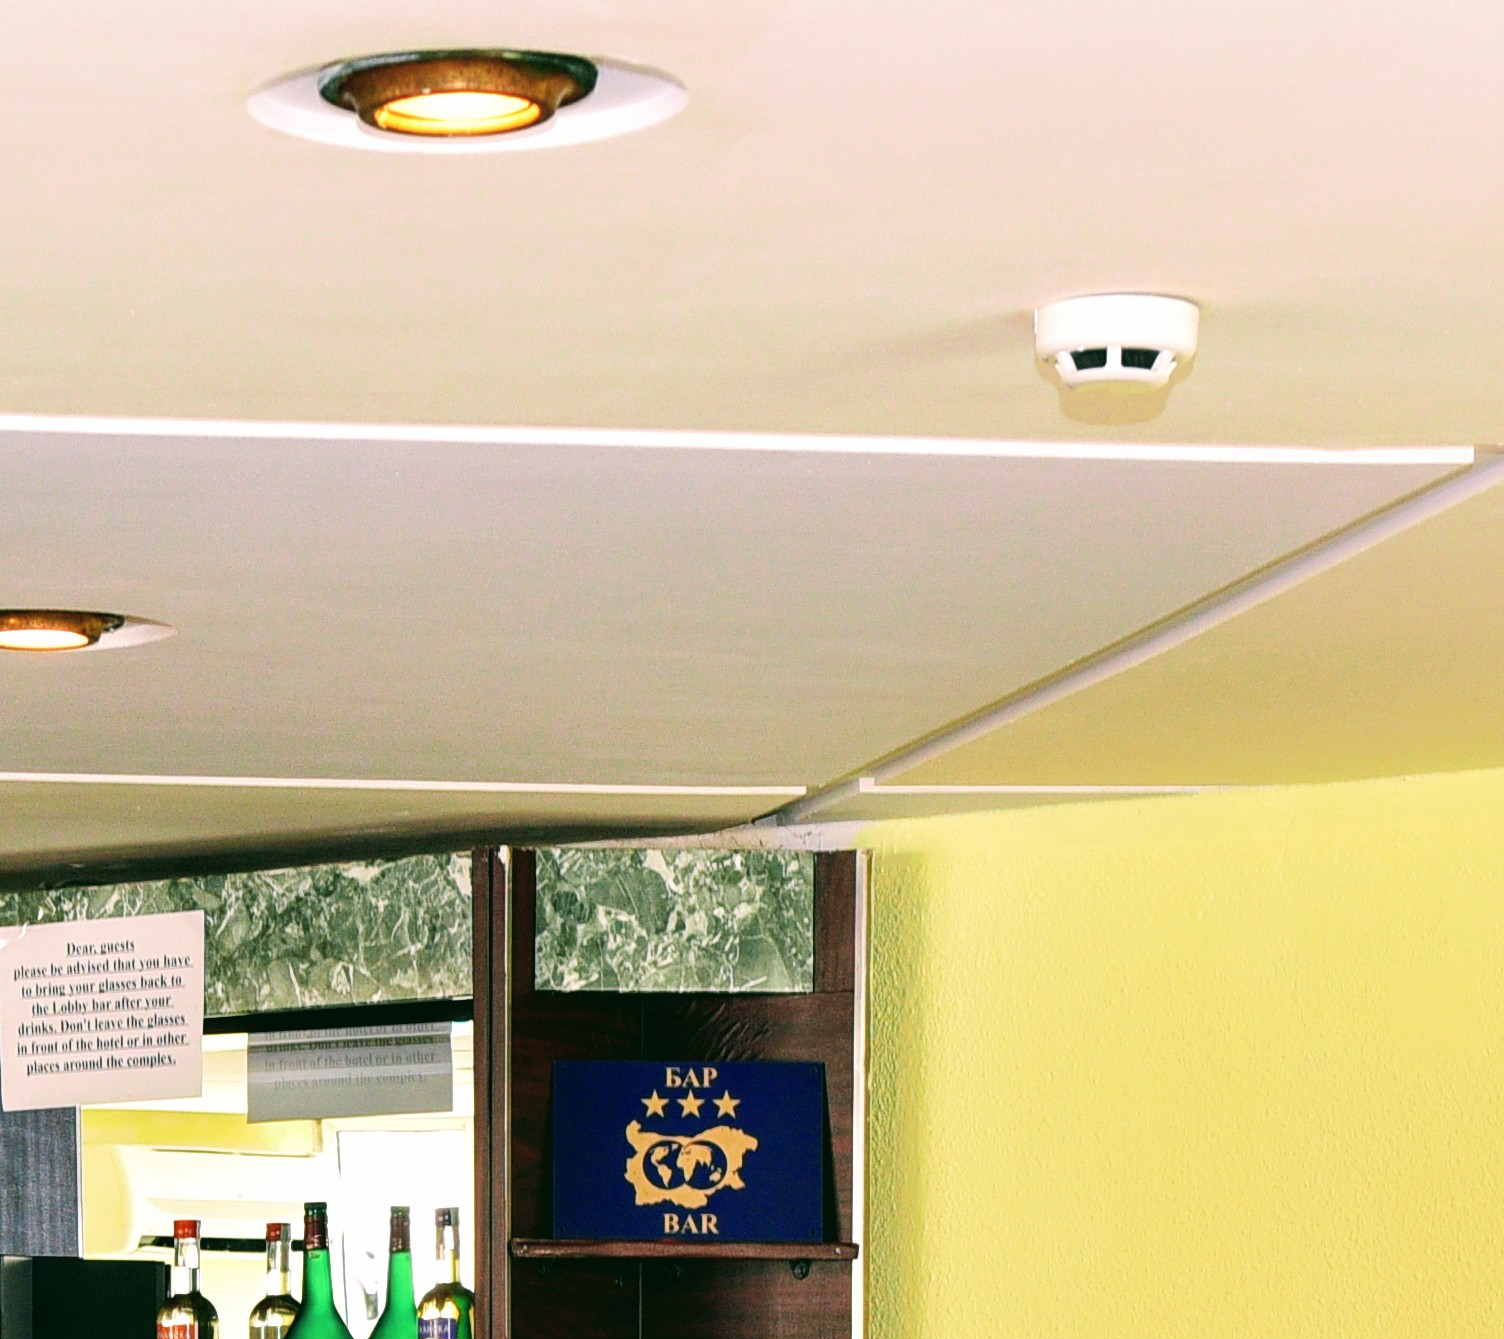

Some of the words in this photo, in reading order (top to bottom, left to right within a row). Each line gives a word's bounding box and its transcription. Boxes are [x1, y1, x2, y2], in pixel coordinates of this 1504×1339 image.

[66, 942, 97, 957] Dear,
[100, 940, 135, 955] guests
[13, 966, 47, 981] please
[50, 965, 63, 976] be
[67, 961, 109, 974] advised
[113, 959, 135, 972] that
[140, 959, 159, 971] you
[164, 954, 191, 968] have
[22, 986, 32, 998] to
[36, 985, 65, 997] bring
[69, 982, 95, 996] your
[99, 977, 136, 992] glasses
[141, 975, 166, 987] back
[171, 975, 182, 986] to
[32, 1005, 48, 1016] the
[53, 1002, 87, 1015] Lobby
[92, 999, 111, 1011] bar
[115, 997, 141, 1010] after
[145, 997, 172, 1010] your
[18, 1024, 56, 1036] drinks.
[61, 1021, 91, 1032] Don't
[95, 1017, 123, 1030] leave
[127, 1017, 143, 1028] the
[148, 1014, 185, 1028] glasses
[17, 1042, 27, 1055] in
[32, 1041, 58, 1054] front
[62, 1040, 72, 1051] of
[76, 1038, 92, 1051] the
[97, 1036, 123, 1050] hotel
[127, 1039, 139, 1048] or
[143, 1035, 152, 1047] in
[156, 1032, 186, 1045] other
[27, 1061, 59, 1076] places
[64, 1058, 102, 1072] around
[107, 1056, 123, 1069] the
[127, 1054, 176, 1068] complex.
[665, 1067, 718, 1088] БАР
[663, 1213, 719, 1234] BAR
